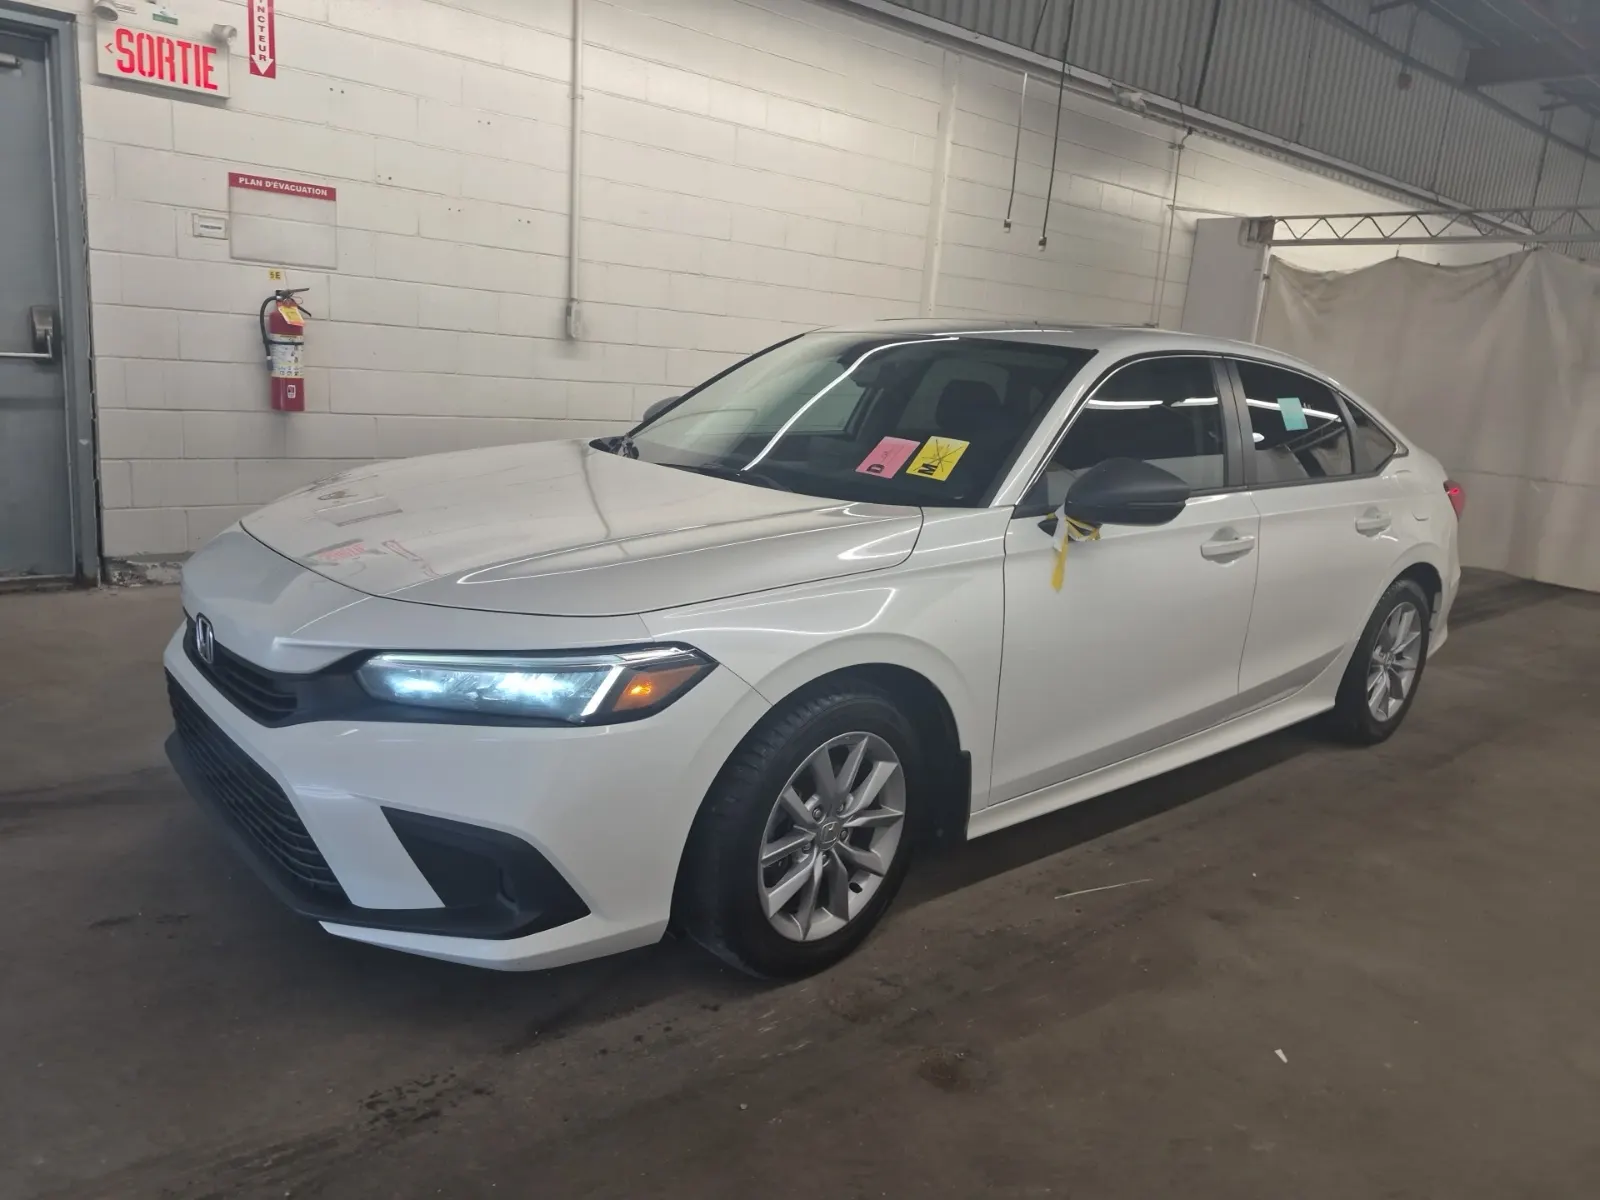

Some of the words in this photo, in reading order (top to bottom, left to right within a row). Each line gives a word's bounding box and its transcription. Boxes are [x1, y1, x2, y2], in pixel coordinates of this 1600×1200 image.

[115, 28, 218, 90] SORTIE
[238, 176, 263, 187] PLAN
[265, 180, 328, 197] D'ÉVACUATION
[866, 463, 885, 473] D
[918, 463, 938, 475] M
